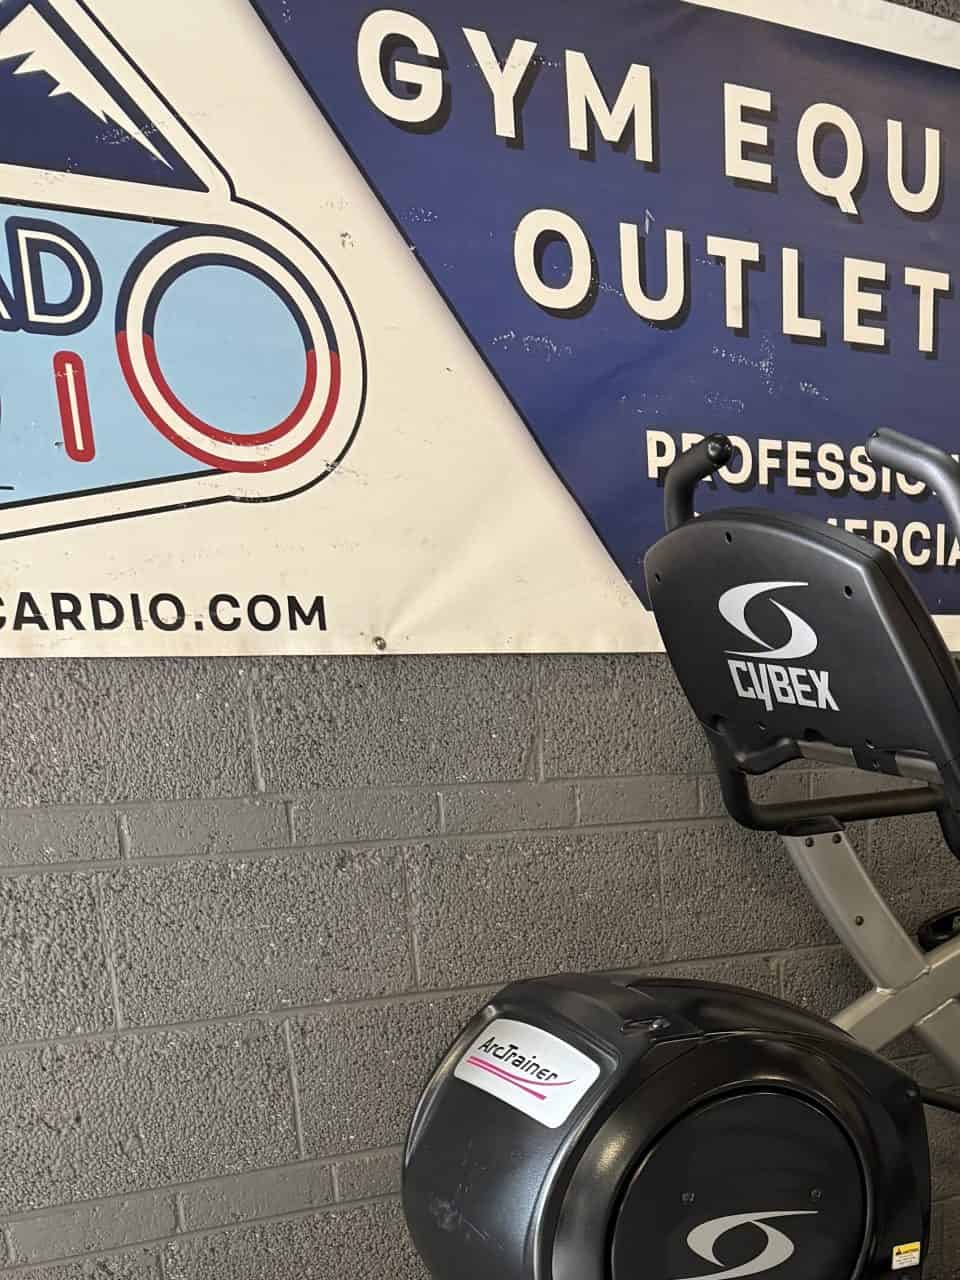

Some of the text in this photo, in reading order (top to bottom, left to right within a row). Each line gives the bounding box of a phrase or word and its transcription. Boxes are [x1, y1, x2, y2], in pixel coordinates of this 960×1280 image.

[356, 9, 653, 163] GYM
[512, 207, 950, 353] OUTLET
[728, 659, 841, 712] CYBEX
[477, 1035, 560, 1083] ArcTrainer
